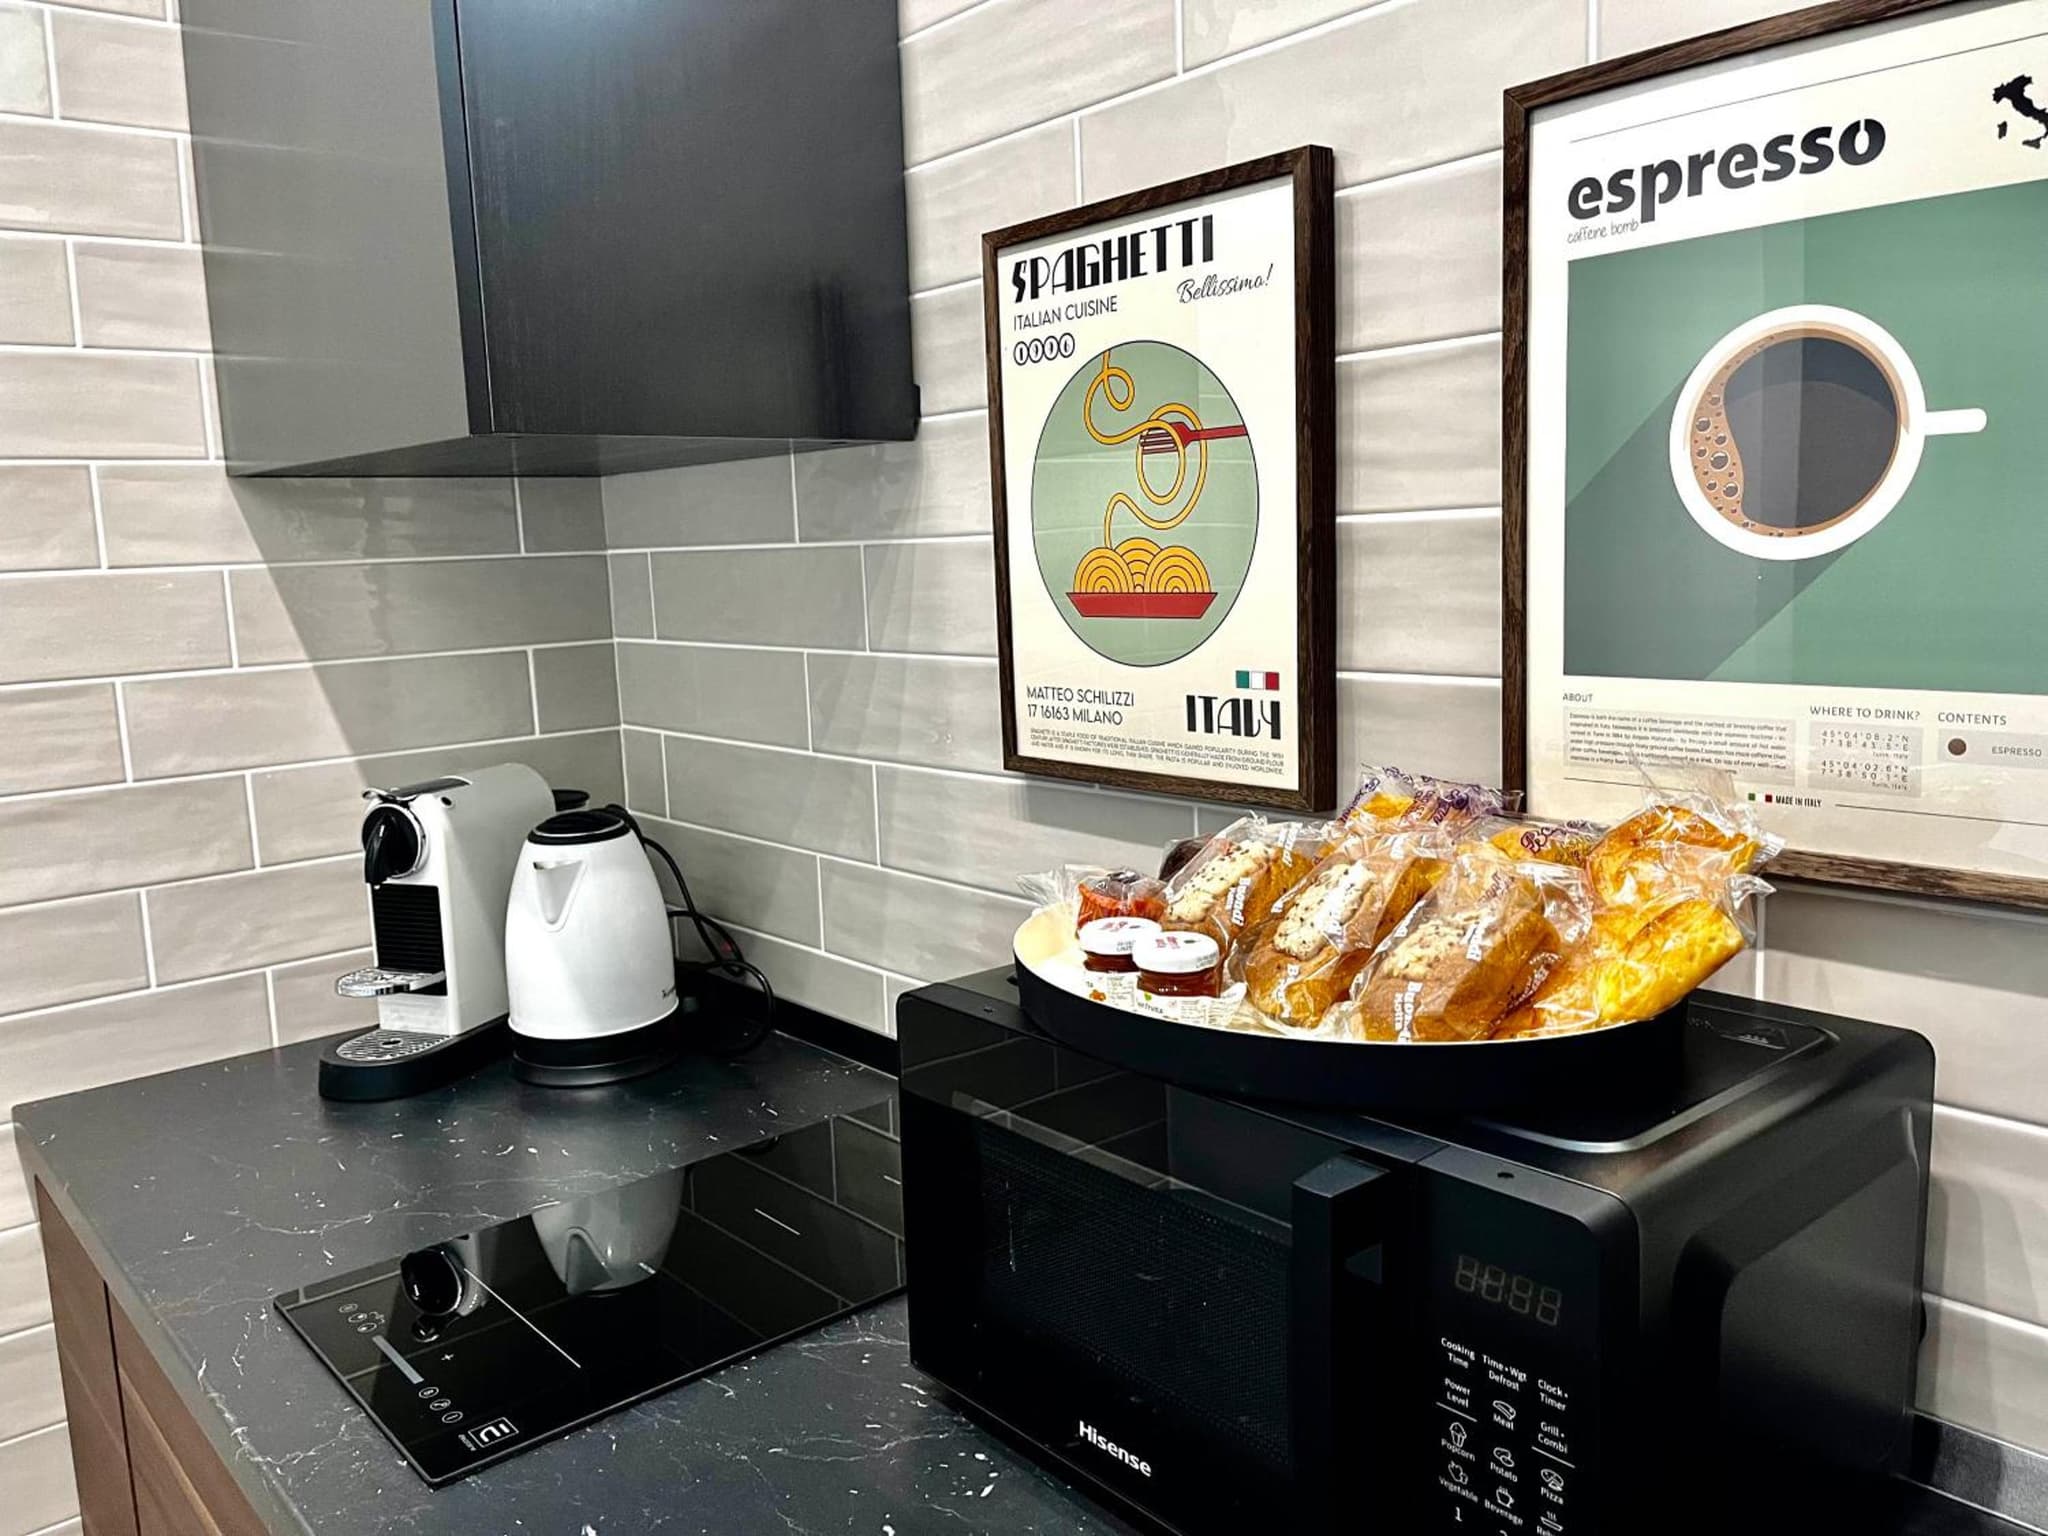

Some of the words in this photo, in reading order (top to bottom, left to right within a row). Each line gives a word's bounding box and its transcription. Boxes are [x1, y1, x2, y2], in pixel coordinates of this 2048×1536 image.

[1567, 118, 1886, 224] espresso
[1610, 218, 1639, 236] bomb
[1011, 214, 1214, 303] SPAGHETTI
[1013, 308, 1062, 331] ITALIAN
[1065, 296, 1118, 320] CUISINE
[1027, 686, 1074, 702] MATTEO
[1076, 689, 1135, 707] SCHILIZZI
[1562, 693, 1594, 703] ABOUT
[1028, 704, 1038, 717] 17
[1040, 704, 1070, 721] 16163
[1072, 708, 1123, 726] MILANO
[1186, 694, 1281, 740] ITALY
[1809, 705, 1853, 717] WHERE
[1855, 707, 1872, 718] TO
[1874, 709, 1921, 721] DRINK?
[1938, 712, 2007, 725] CONTENTS
[1991, 745, 2043, 758] ESPRESSO
[1775, 795, 1793, 805] MADE
[1794, 797, 1803, 806] IN
[1804, 798, 1822, 807] ITALY
[1441, 1337, 1475, 1360] Cooking
[1448, 1352, 1469, 1369] Time
[1445, 1377, 1470, 1396] Power
[1488, 1369, 1519, 1392] Defrost
[1447, 1391, 1469, 1408] Level
[1540, 1392, 1566, 1411] Timer
[1079, 1420, 1152, 1477] Hisense
[1441, 1438, 1475, 1461] Popcorn
[1538, 1433, 1568, 1454] Combi
[1490, 1461, 1518, 1482] Potato
[1438, 1475, 1478, 1503] Vegetable
[1540, 1486, 1564, 1505] Pizza
[1455, 1506, 1463, 1522] 1
[1484, 1499, 1523, 1526] Beverage
